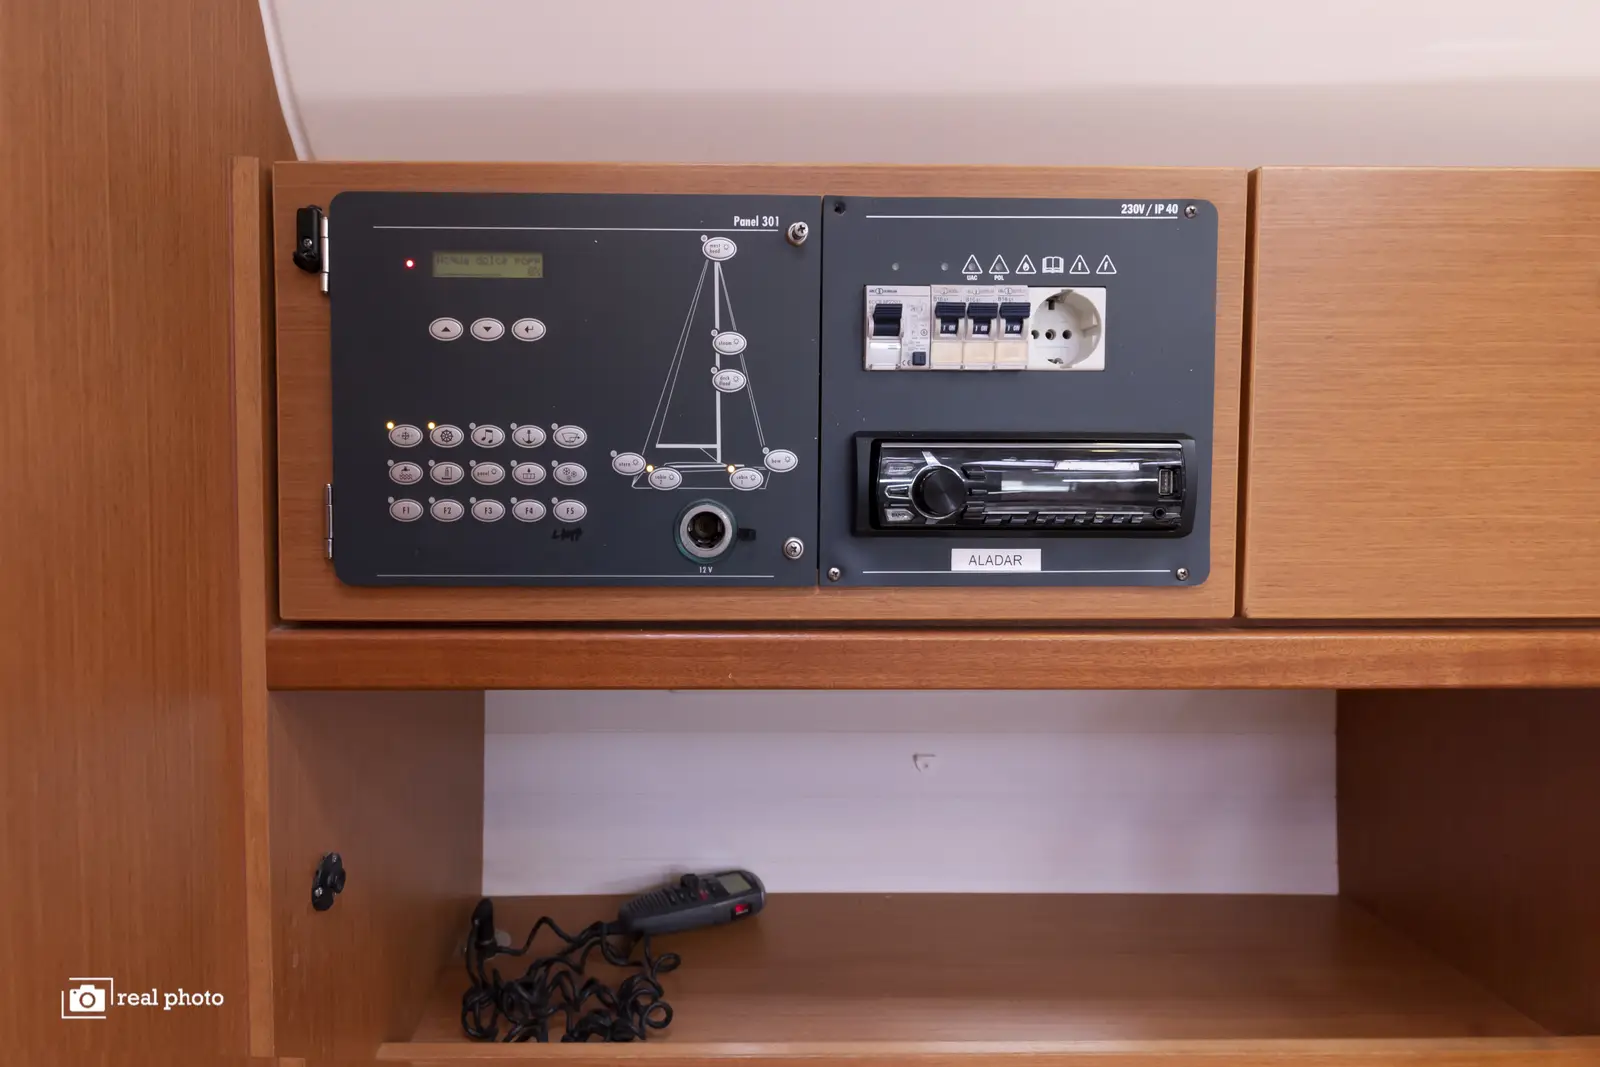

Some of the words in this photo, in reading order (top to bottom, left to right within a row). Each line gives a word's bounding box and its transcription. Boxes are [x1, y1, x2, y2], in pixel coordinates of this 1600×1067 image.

[1121, 204, 1145, 215] 230V
[1145, 204, 1153, 217] /
[1154, 204, 1165, 215] IP
[1165, 204, 1179, 215] 40
[733, 215, 760, 227] Panel
[761, 216, 779, 227] 301
[402, 506, 410, 515] F1
[443, 506, 452, 515] F2
[484, 506, 493, 515] F3
[525, 506, 534, 515] F4
[566, 506, 575, 515] F5
[968, 554, 1023, 566] ALADAR
